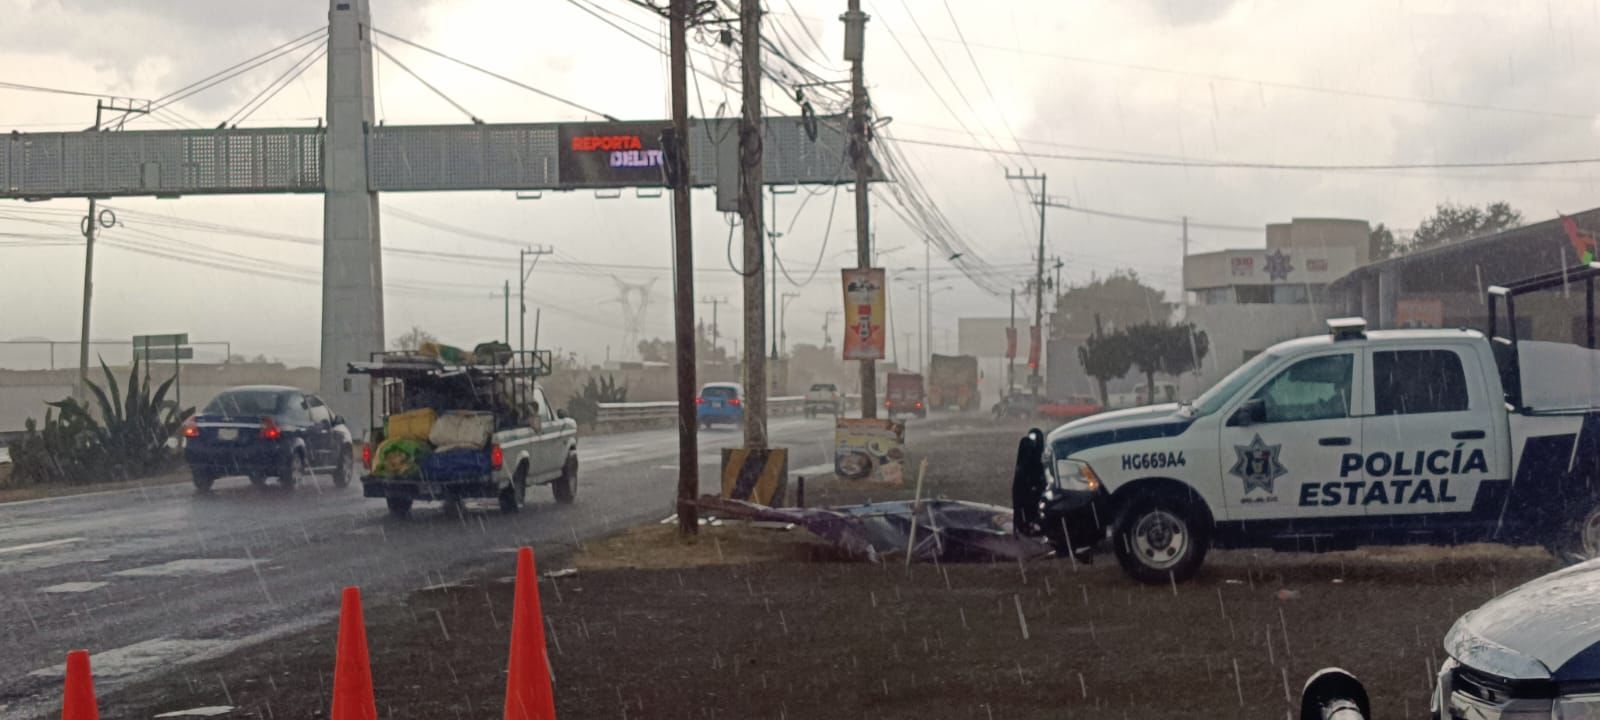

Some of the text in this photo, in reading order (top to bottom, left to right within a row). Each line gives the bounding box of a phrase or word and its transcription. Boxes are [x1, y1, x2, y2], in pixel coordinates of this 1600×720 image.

[571, 135, 642, 151] REPORTA
[1121, 451, 1187, 471] HG669A4
[1339, 442, 1489, 478] POLICÍA
[1298, 478, 1457, 507] ESTATAL
